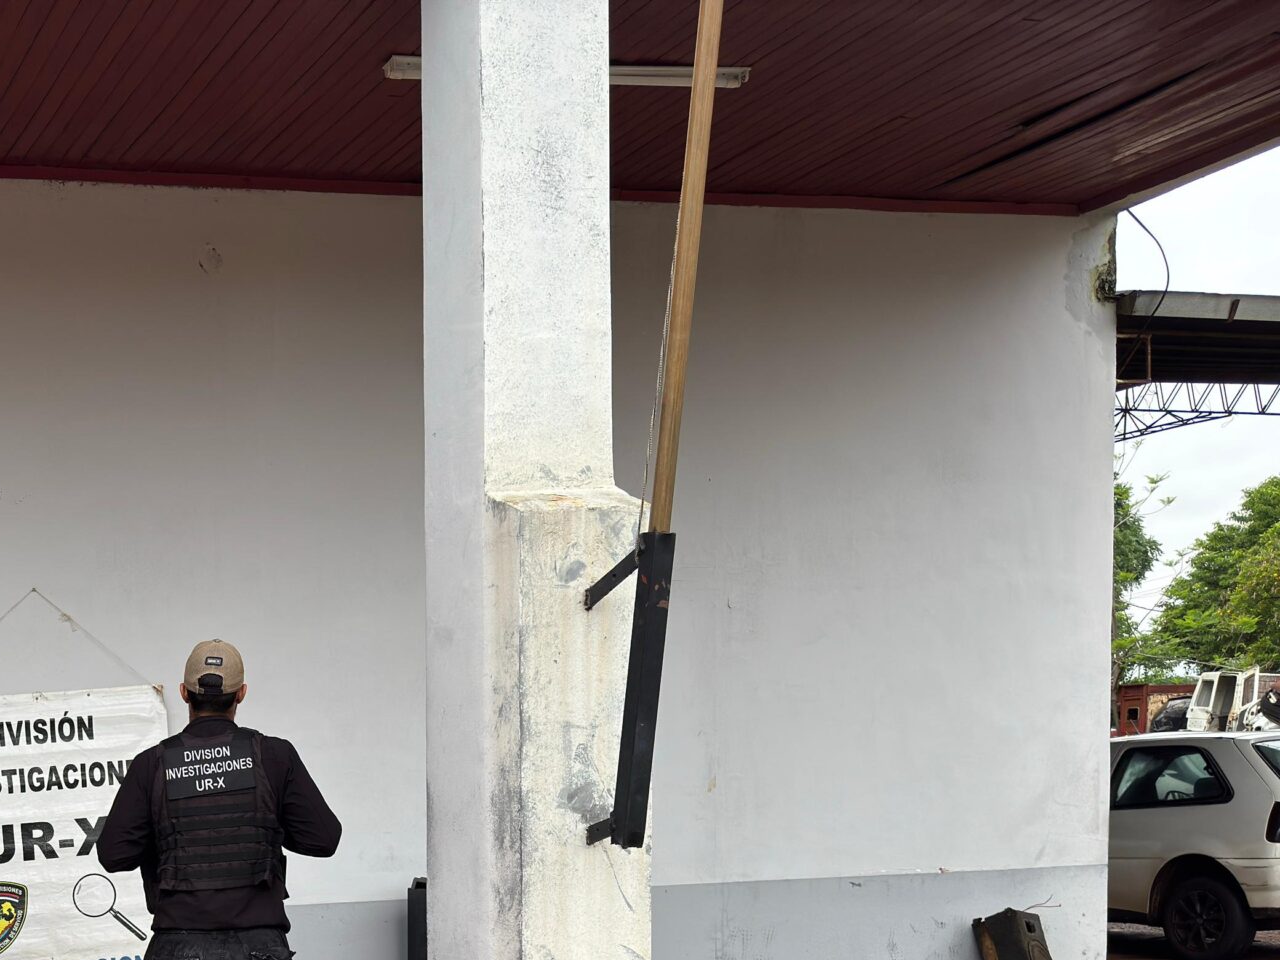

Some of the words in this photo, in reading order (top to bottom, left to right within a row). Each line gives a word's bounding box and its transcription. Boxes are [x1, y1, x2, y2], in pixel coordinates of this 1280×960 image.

[183, 745, 231, 762] DIVISION
[165, 757, 253, 780] INVESTIGACIONES
[195, 776, 226, 792] UR-X
